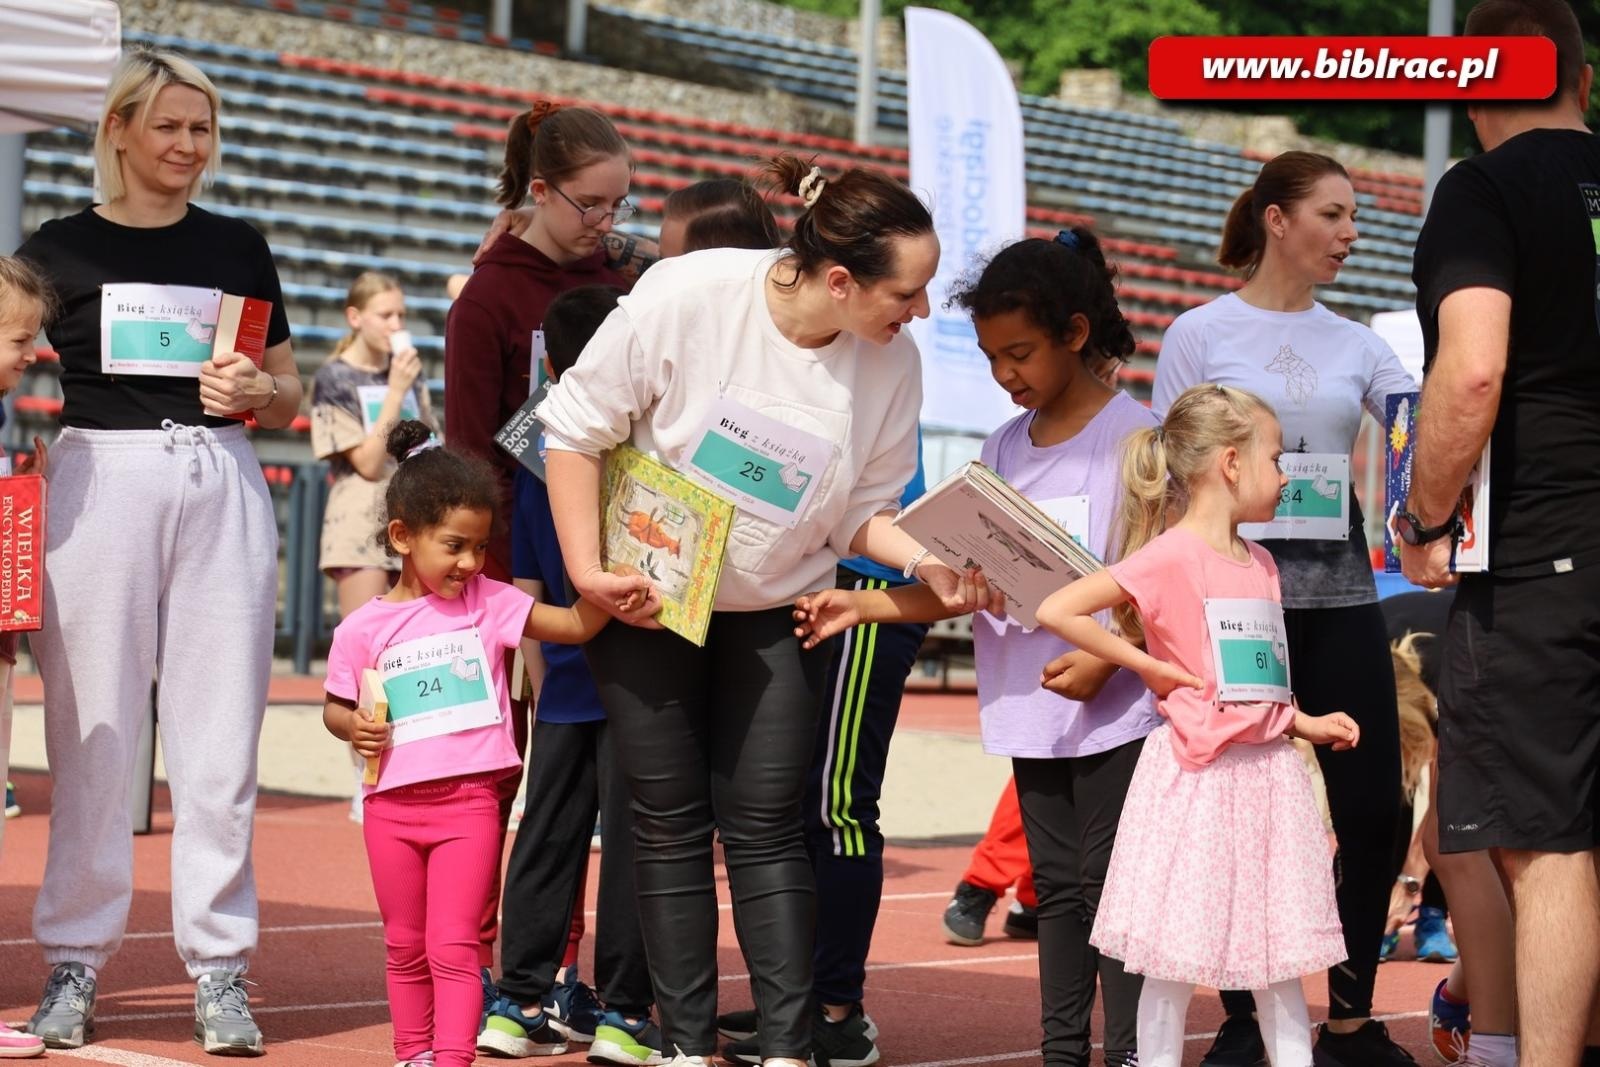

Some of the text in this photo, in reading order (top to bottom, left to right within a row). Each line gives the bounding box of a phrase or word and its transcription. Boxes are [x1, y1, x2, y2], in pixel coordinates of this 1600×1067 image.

[117, 303, 145, 314] Bieg
[160, 304, 203, 316] książką
[160, 332, 170, 347] 5
[502, 402, 541, 450] DOKTO
[505, 410, 527, 432] FLEMING
[511, 438, 530, 457] NO
[720, 417, 750, 440] Bieg
[761, 437, 807, 464] książką
[739, 461, 767, 482] 25
[1286, 463, 1328, 474] książką
[1281, 489, 1303, 504] 34
[1, 496, 13, 615] ENCYKLOPEDIA
[17, 505, 33, 601] WIELKA
[1220, 620, 1243, 632] Bieg
[383, 656, 403, 672] Bieg
[417, 643, 464, 661] książką
[1255, 652, 1268, 669] 61
[417, 677, 443, 698] 24
